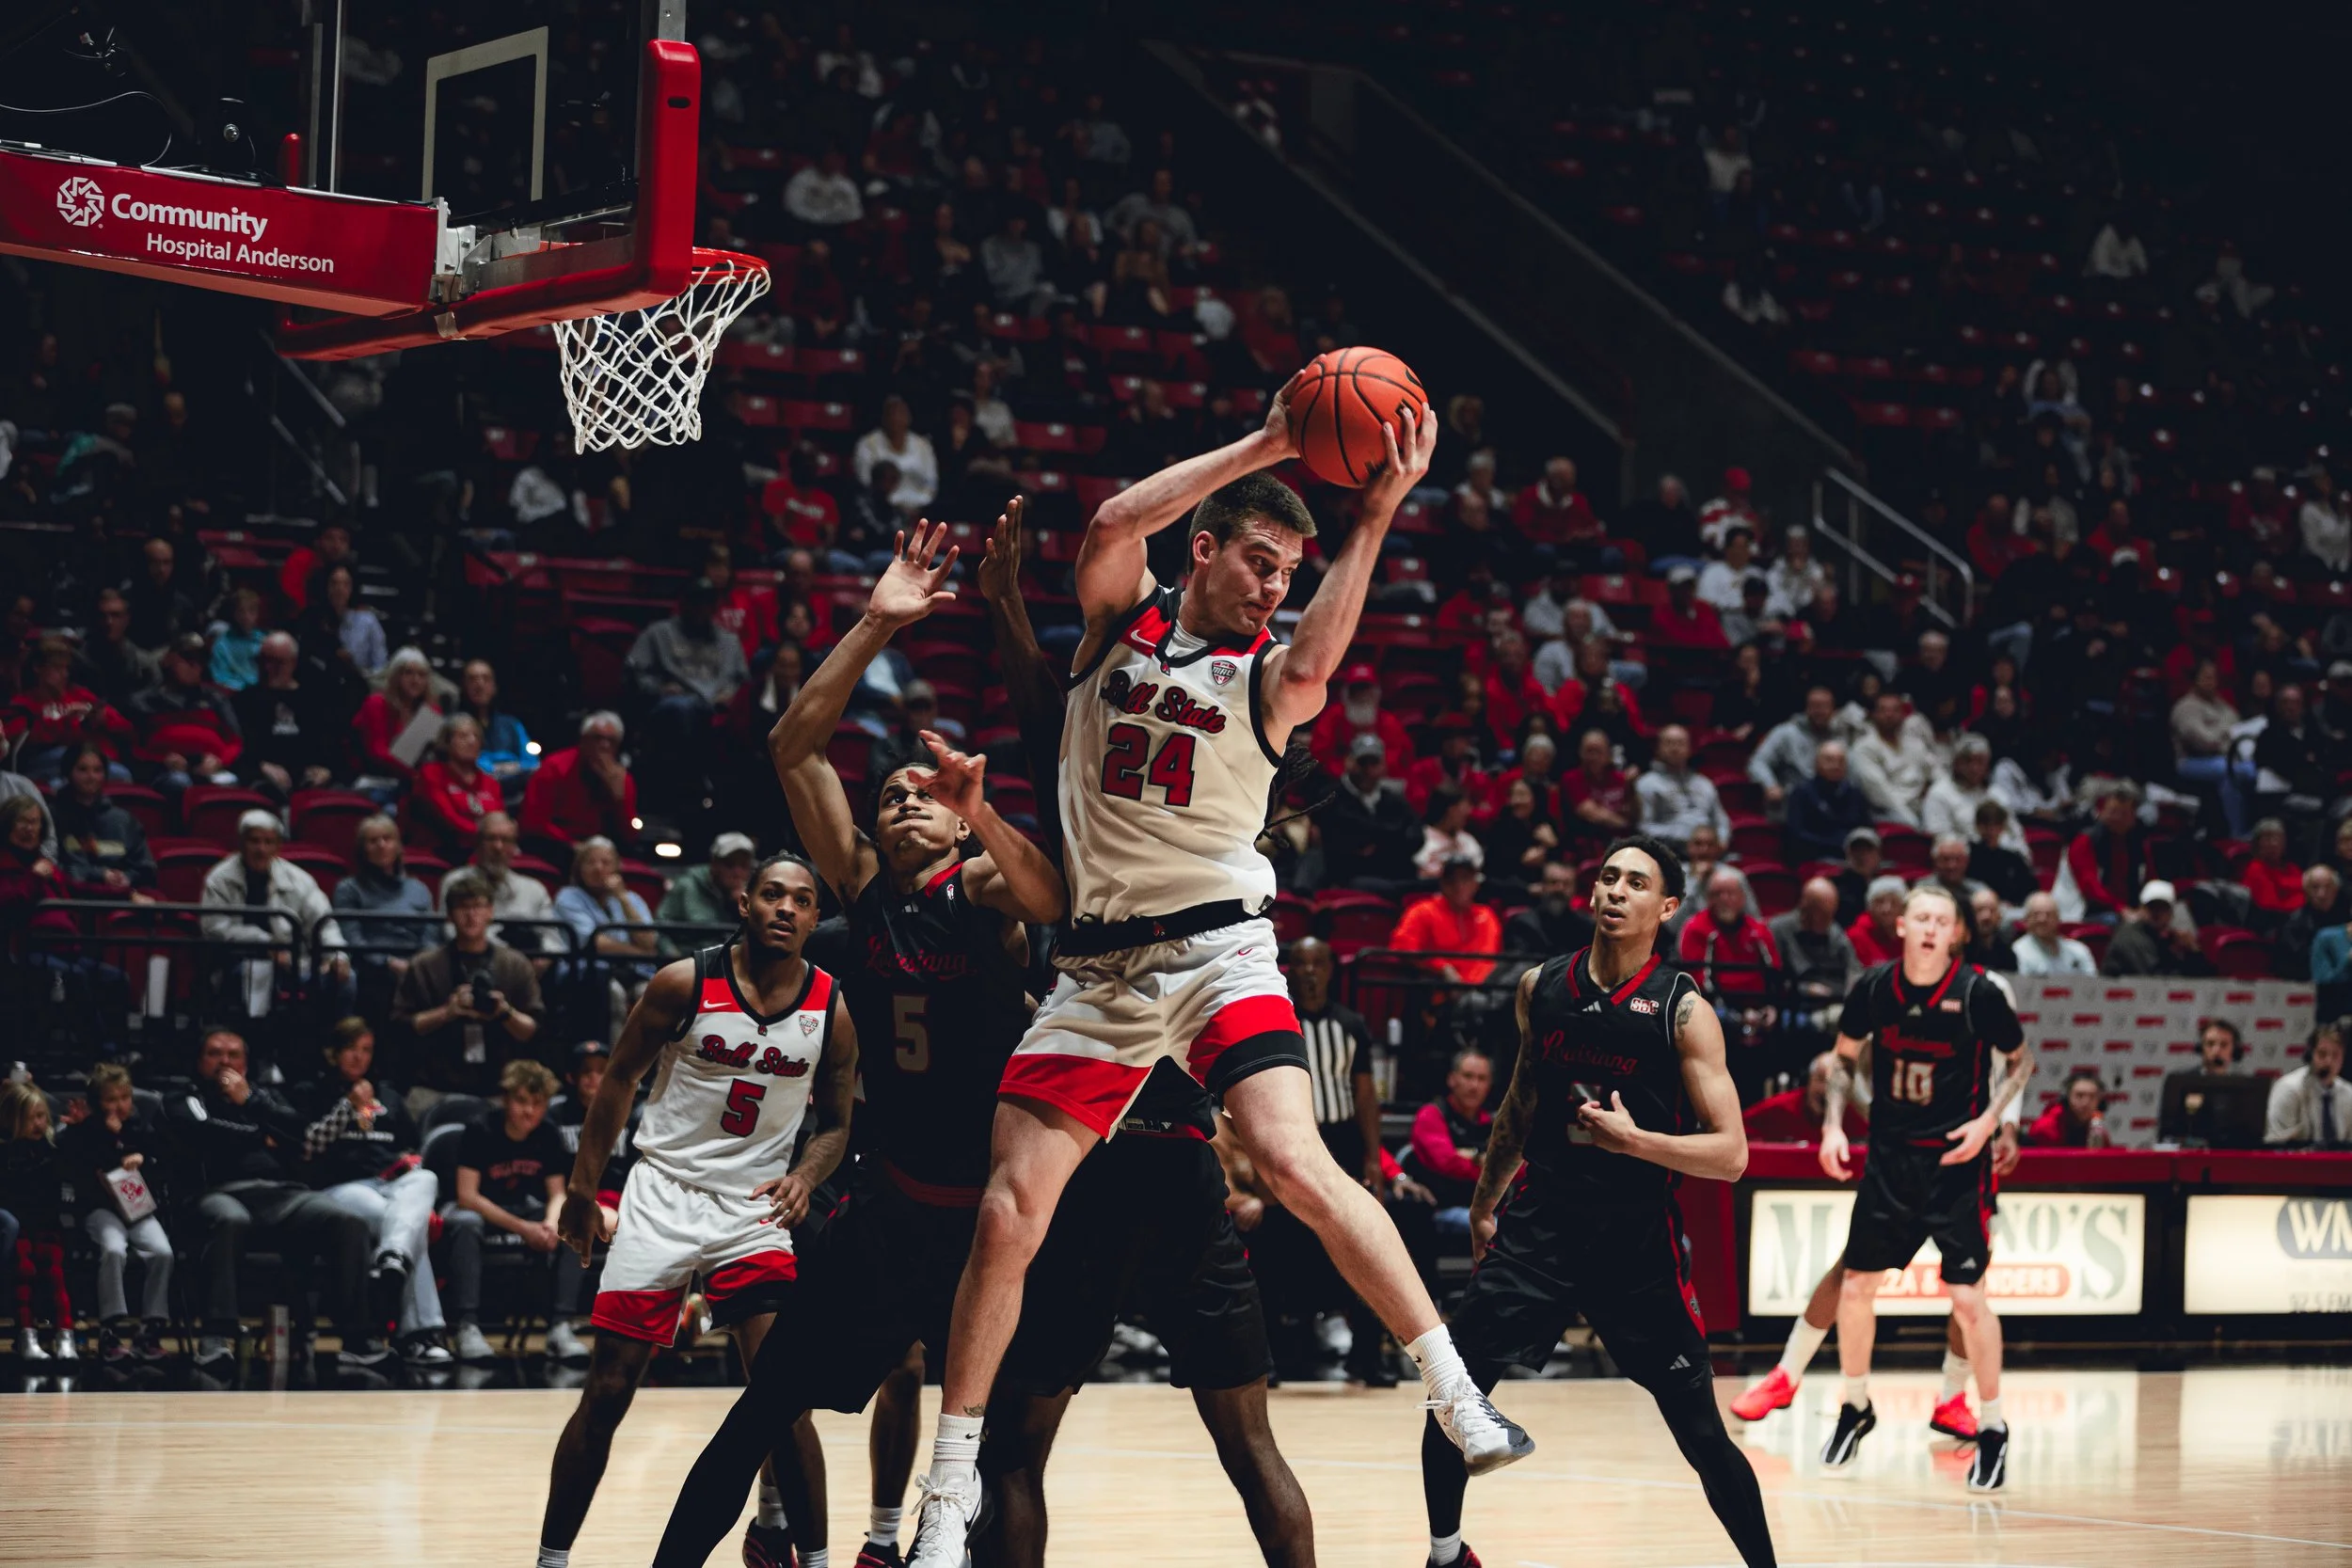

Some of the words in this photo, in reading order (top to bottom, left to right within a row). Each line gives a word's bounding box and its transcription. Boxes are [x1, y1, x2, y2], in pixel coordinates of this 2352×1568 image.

[111, 193, 268, 243] Community
[146, 232, 231, 261] Hospital
[235, 244, 335, 274] Anderson
[1154, 686, 1227, 735] State
[1100, 721, 1197, 808] 24
[695, 1034, 758, 1069] Ball
[891, 990, 931, 1074] 5
[1892, 1057, 1936, 1106] 10
[720, 1077, 768, 1138] 5
